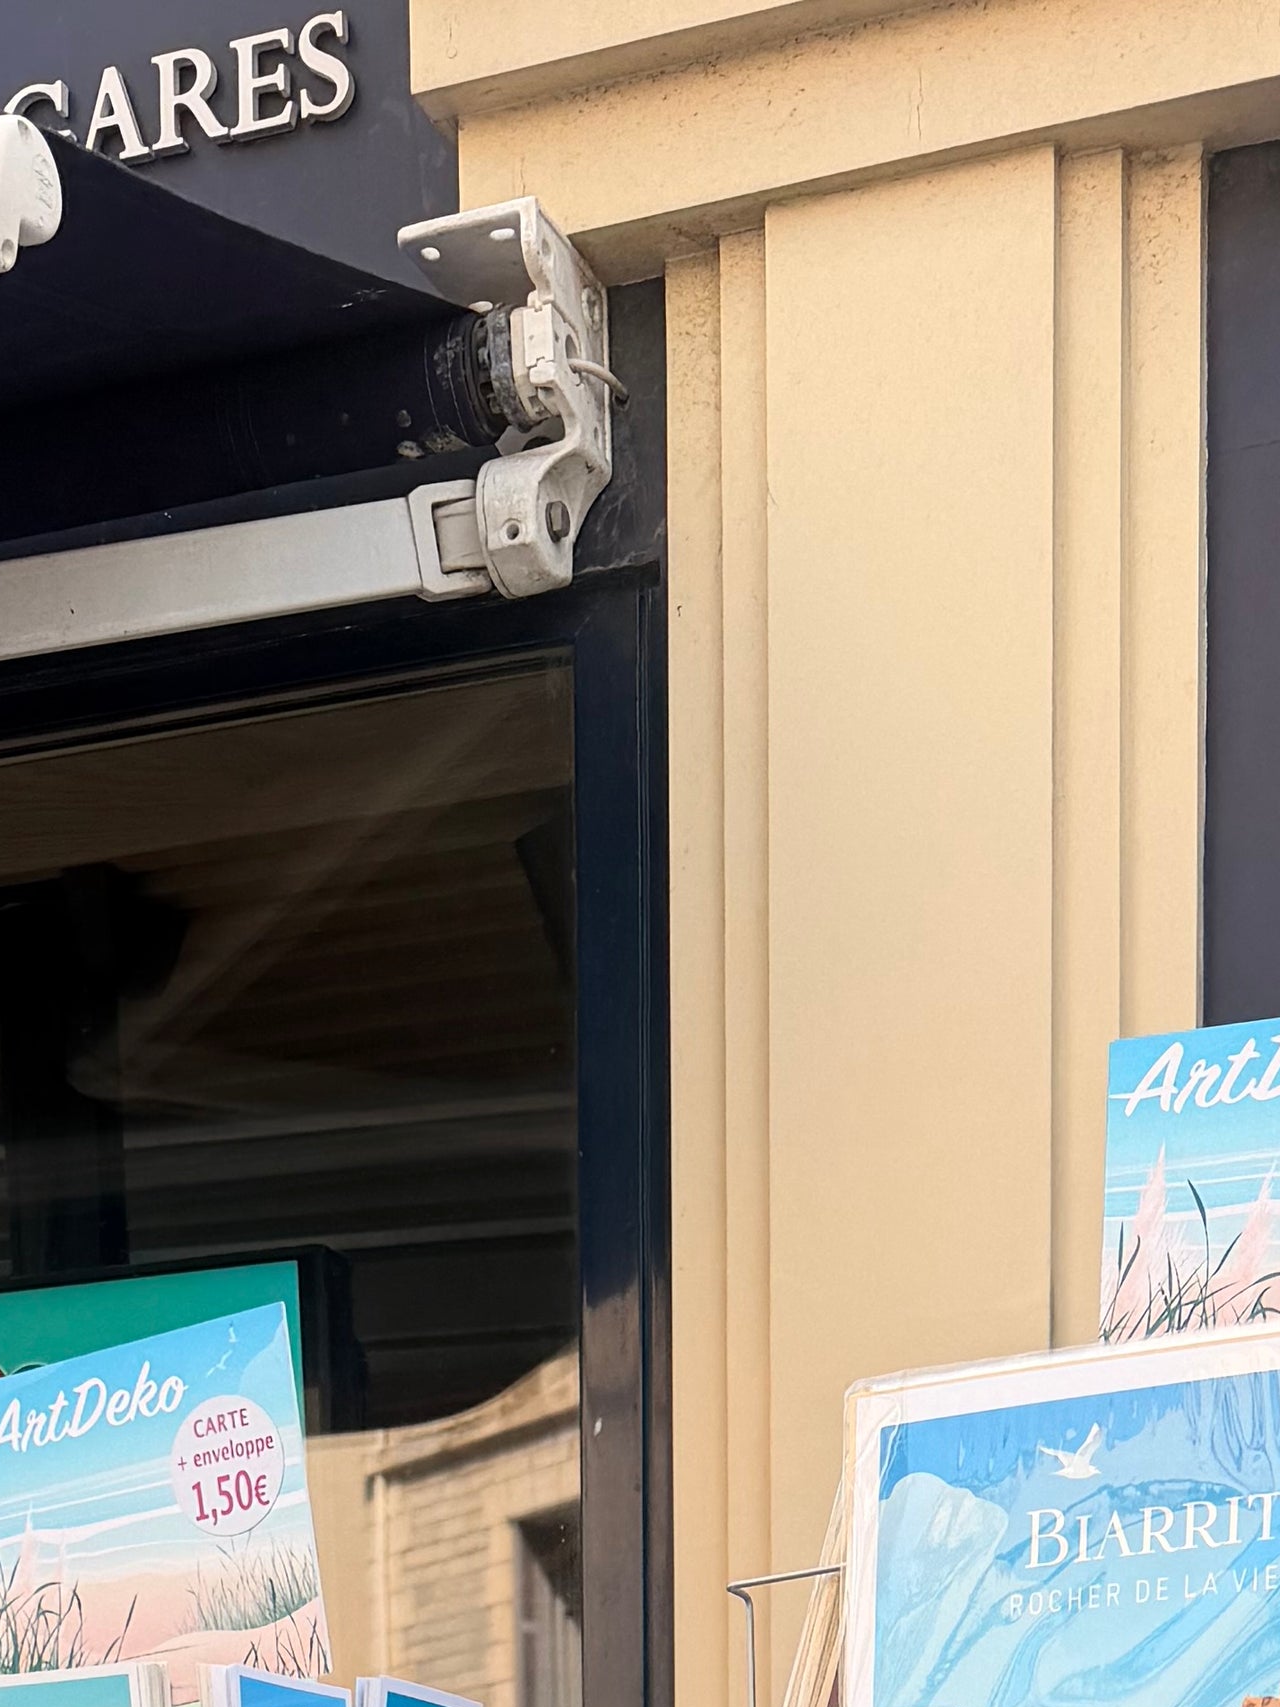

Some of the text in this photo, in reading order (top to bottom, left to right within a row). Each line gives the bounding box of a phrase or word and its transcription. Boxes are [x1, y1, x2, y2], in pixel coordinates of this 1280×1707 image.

[193, 1408, 250, 1439] CARTE
[193, 1435, 275, 1469] enveloppe
[191, 1470, 271, 1527] 1,50€
[1009, 1582, 1121, 1617] ROCHER
[1135, 1577, 1169, 1604] DE
[1183, 1572, 1219, 1599] LA
